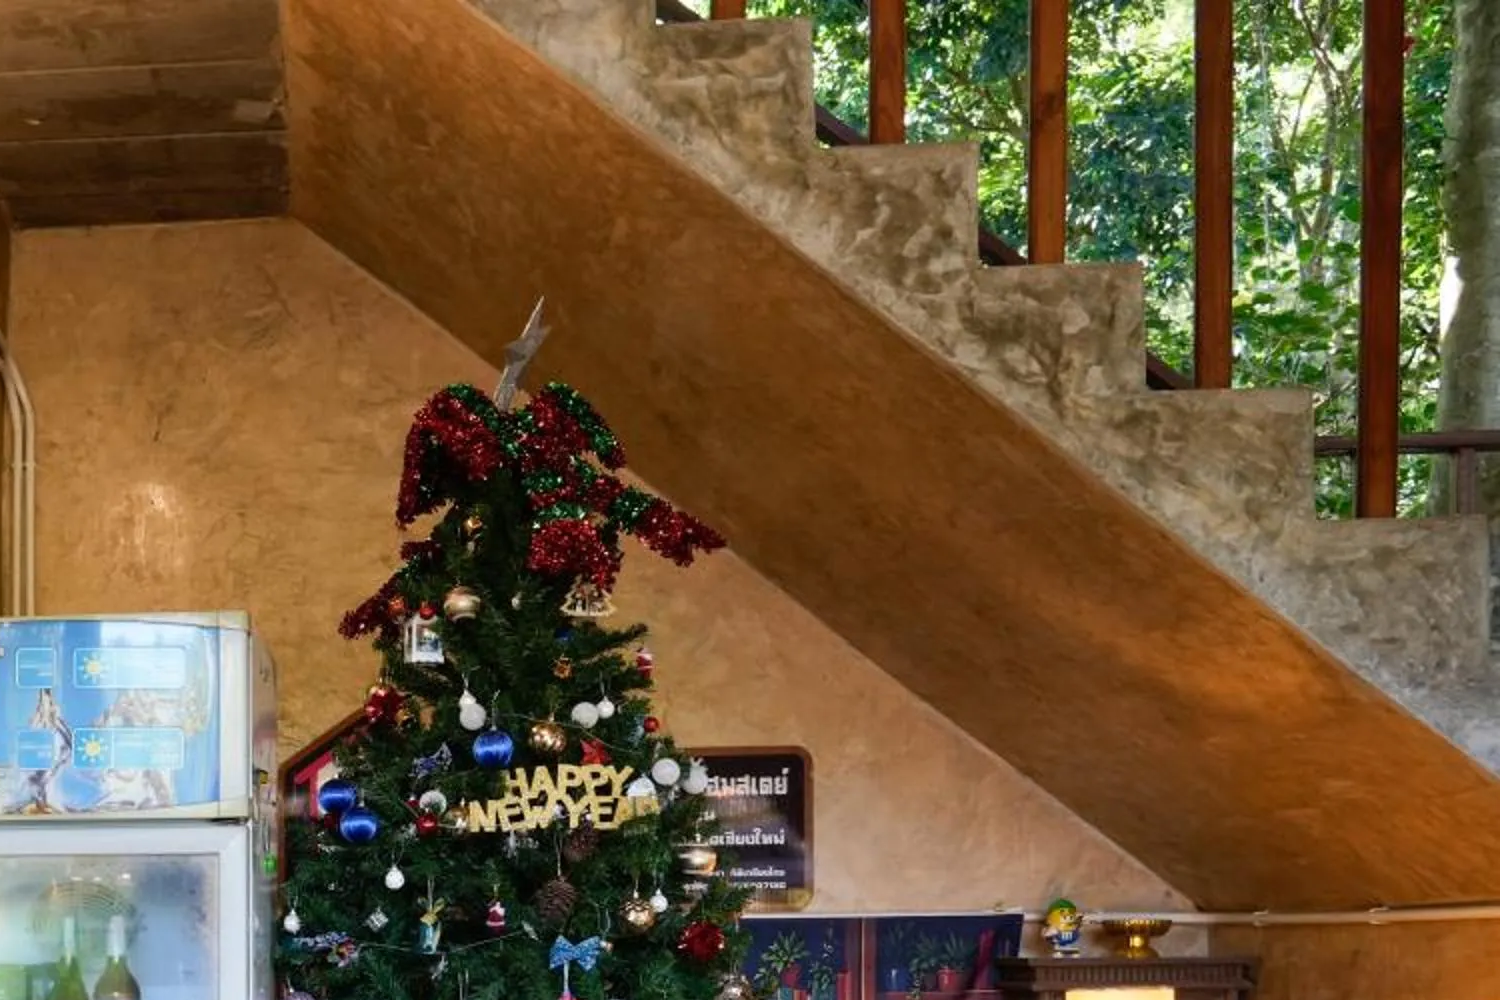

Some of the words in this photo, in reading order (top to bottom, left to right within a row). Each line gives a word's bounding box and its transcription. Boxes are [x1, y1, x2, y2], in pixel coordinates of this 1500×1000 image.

[501, 764, 634, 799] HAPPY
[707, 767, 789, 797] ฮมสเตย์
[469, 797, 562, 832] NEW
